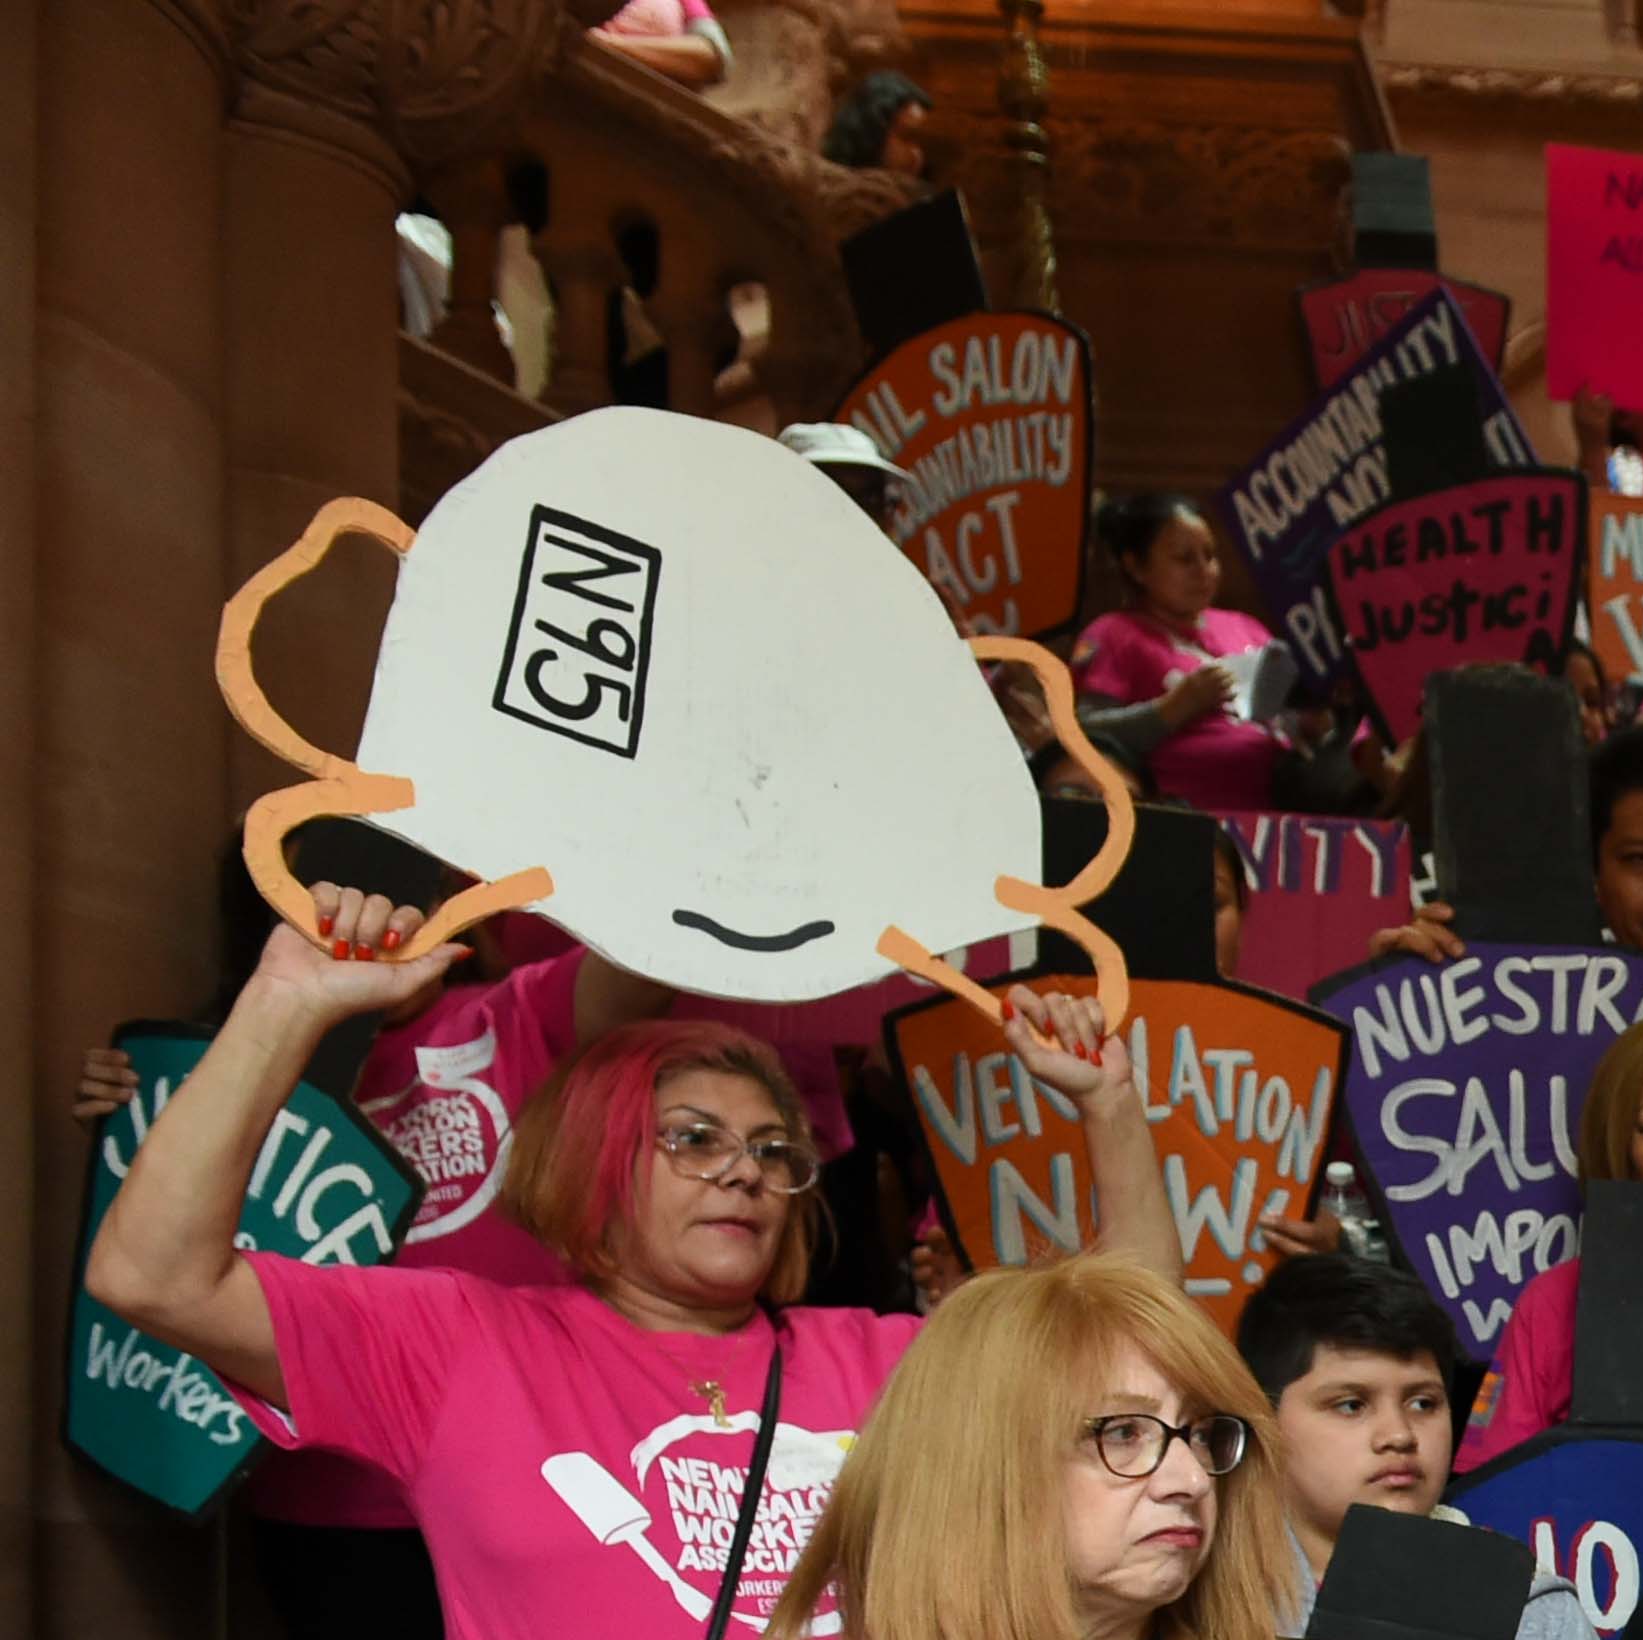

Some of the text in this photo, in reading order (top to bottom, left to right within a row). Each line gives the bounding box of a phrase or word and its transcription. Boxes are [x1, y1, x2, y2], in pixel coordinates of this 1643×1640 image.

[929, 330, 1078, 417] SALON
[924, 490, 1022, 604] ACT
[1341, 496, 1566, 578] HEALTH
[524, 533, 641, 722] N95
[914, 1016, 1331, 1184] VENLATION
[104, 1073, 392, 1266] JTICE
[988, 1152, 1290, 1286] NW!
[86, 1323, 248, 1447] Workers
[659, 1456, 744, 1494] NEW
